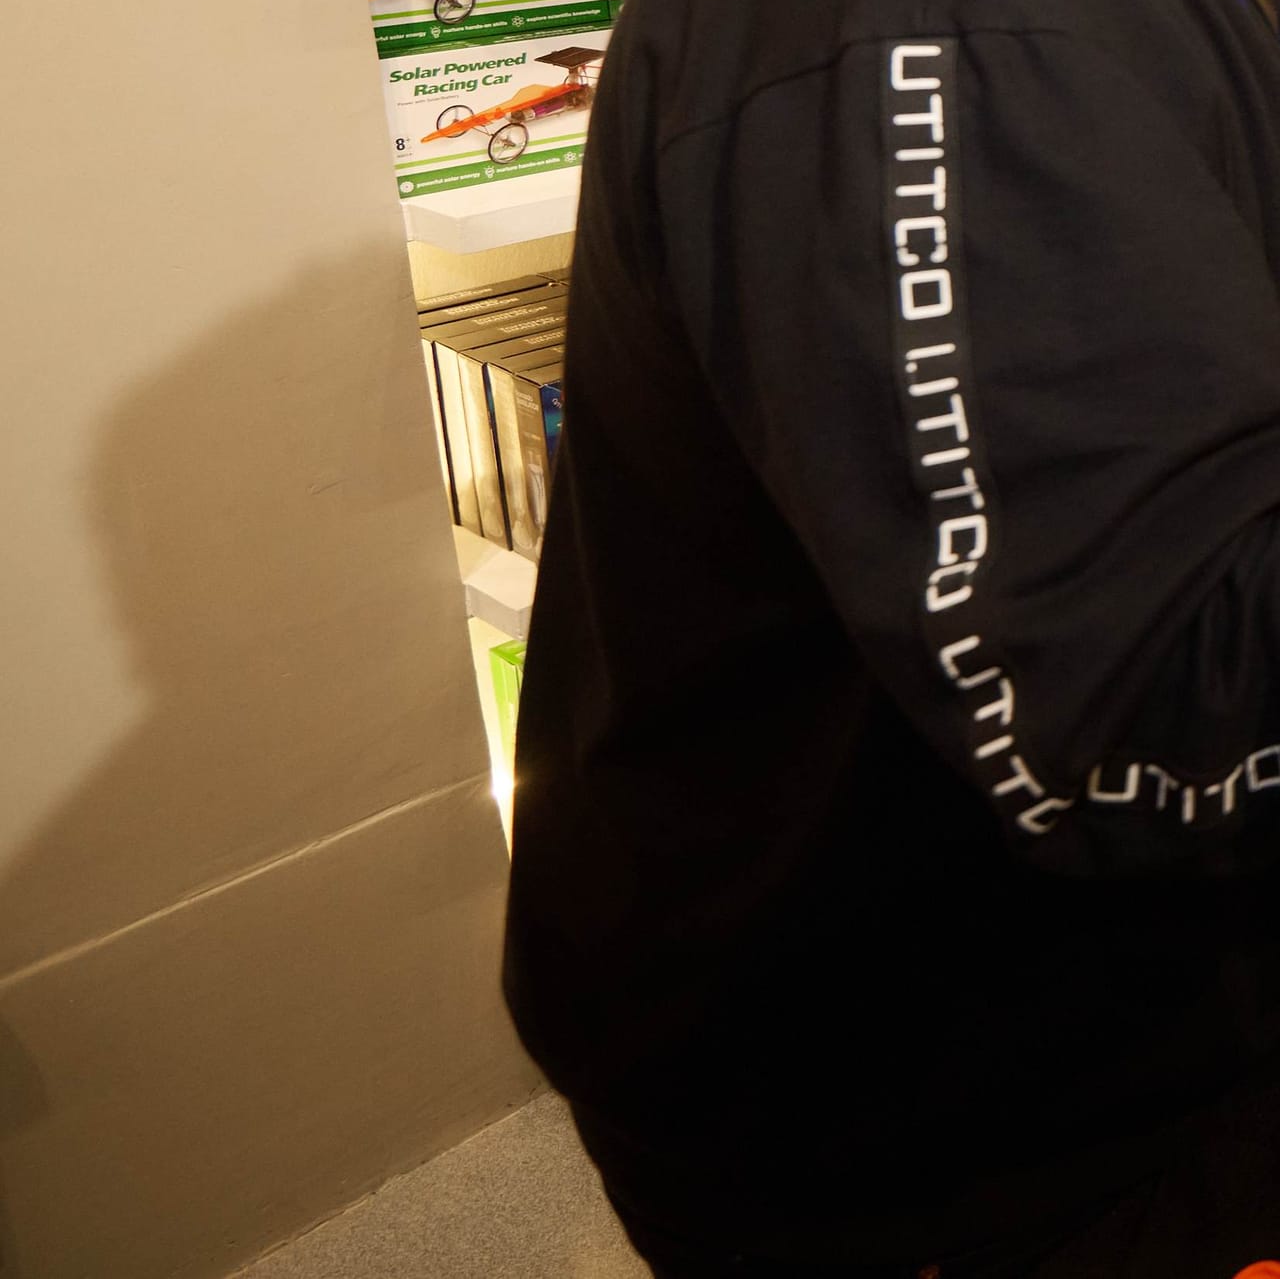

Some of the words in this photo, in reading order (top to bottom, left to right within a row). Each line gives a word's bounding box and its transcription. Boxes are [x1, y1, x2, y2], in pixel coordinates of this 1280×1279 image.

[390, 67, 440, 83] Solar
[444, 52, 527, 74] Powered
[414, 77, 478, 97] Racing
[481, 73, 512, 86] Car
[891, 45, 953, 320] UTITCO
